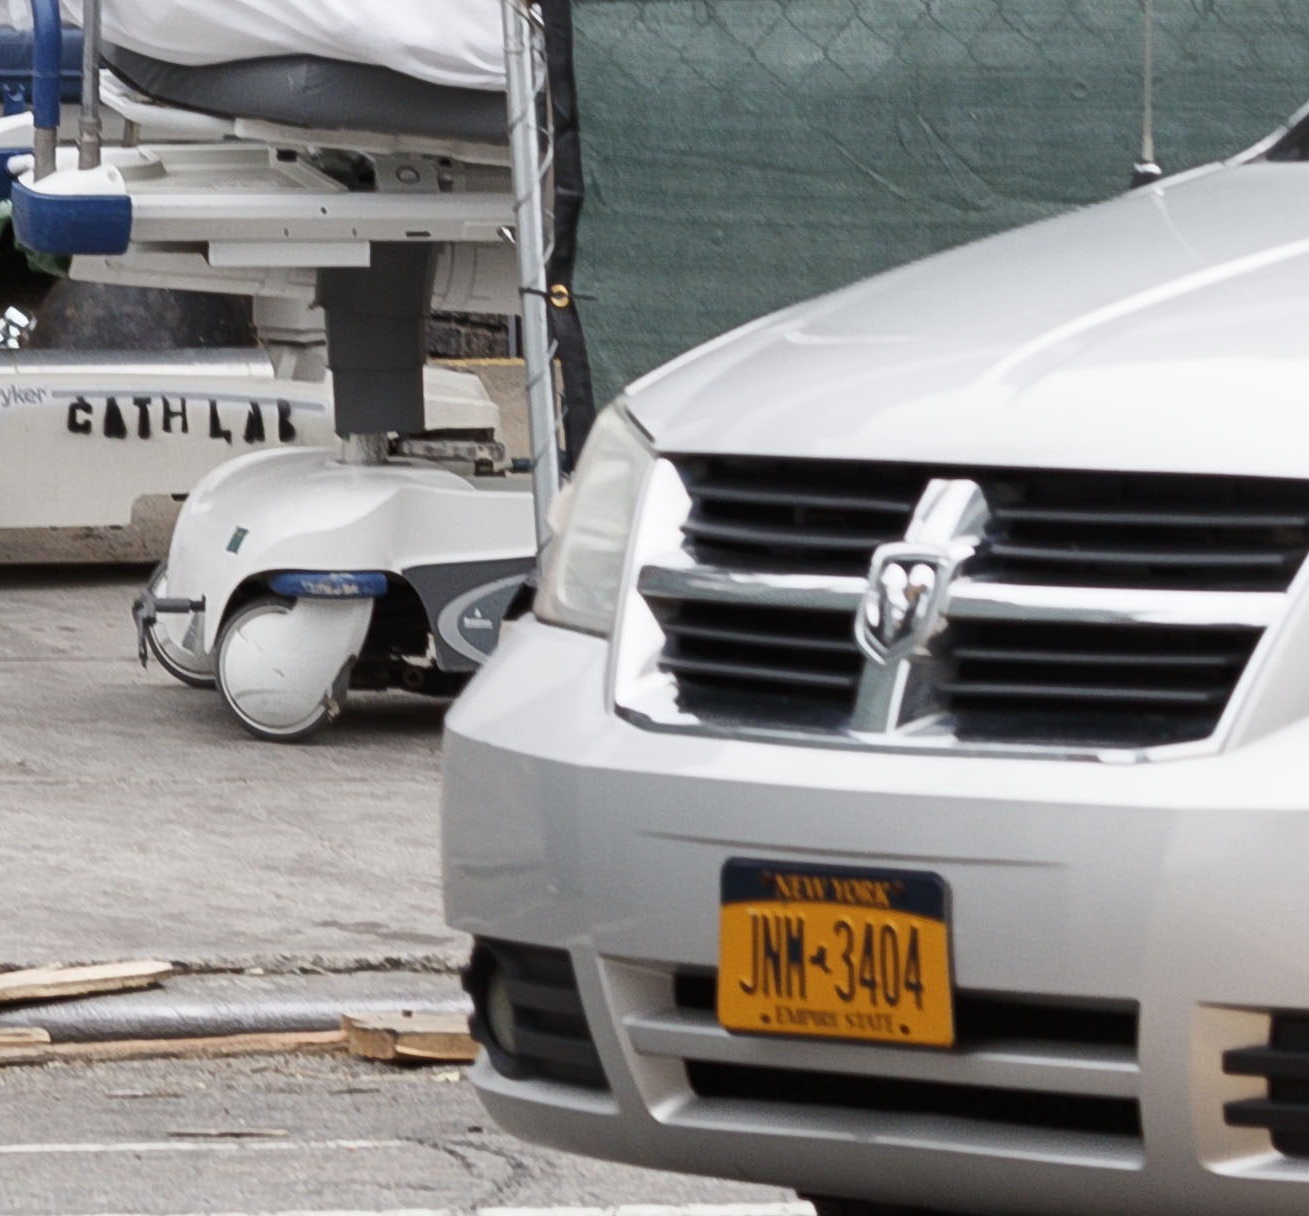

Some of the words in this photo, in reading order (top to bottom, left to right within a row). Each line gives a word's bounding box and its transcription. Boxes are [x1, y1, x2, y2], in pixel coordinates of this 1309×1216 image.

[67, 395, 188, 440] CATH
[209, 398, 296, 444] LAB
[775, 874, 826, 902] NEW
[830, 877, 891, 909] YORK
[834, 920, 924, 1011] 3404
